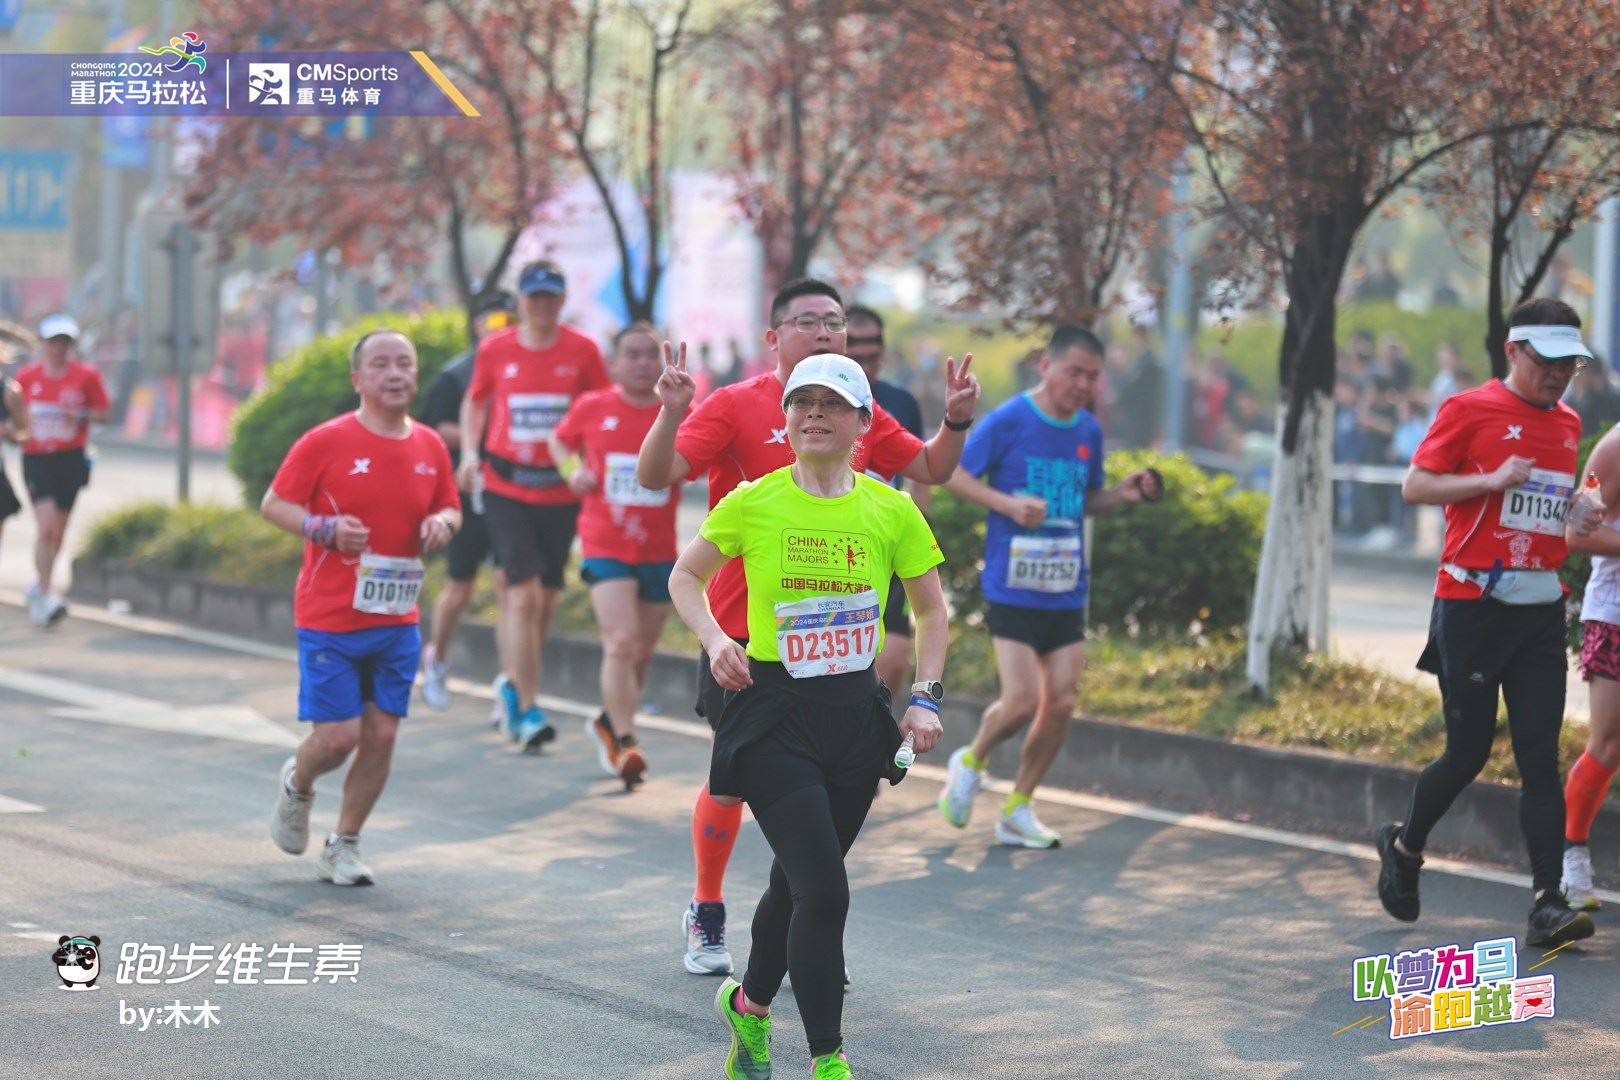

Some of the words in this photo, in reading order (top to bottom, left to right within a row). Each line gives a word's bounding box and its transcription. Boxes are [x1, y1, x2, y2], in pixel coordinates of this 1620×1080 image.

[787, 535, 828, 548] CHINA
[787, 546, 829, 556] MARATHON
[787, 554, 829, 564] MAJORS
[786, 624, 875, 663] D23517
